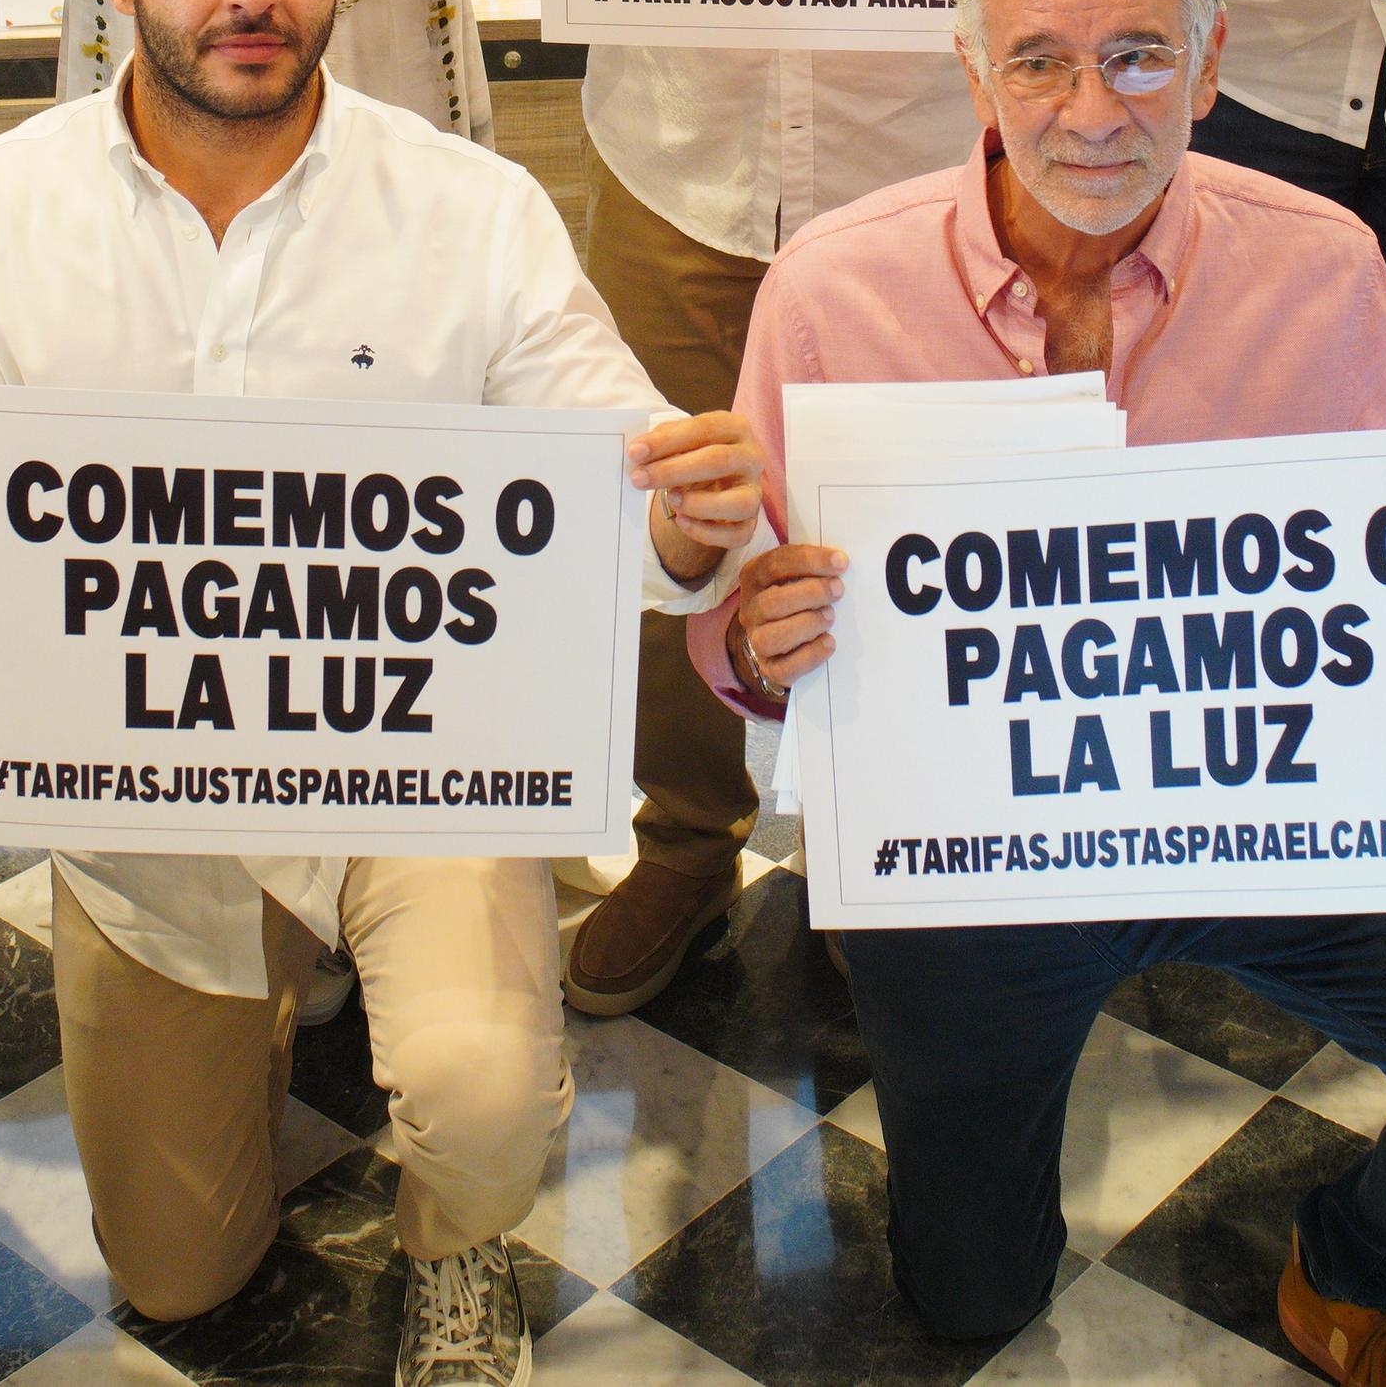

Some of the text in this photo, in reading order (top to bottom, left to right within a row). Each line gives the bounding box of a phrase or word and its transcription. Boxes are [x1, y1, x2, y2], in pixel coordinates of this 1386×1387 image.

[7, 461, 554, 556] COMEMOS O
[65, 559, 497, 645] PAGAMOS
[886, 510, 1335, 615] COMEMOS
[126, 653, 433, 733] LA LUZ
[945, 604, 1373, 706] PAGAMOS
[1009, 704, 1317, 796] LA LUZ
